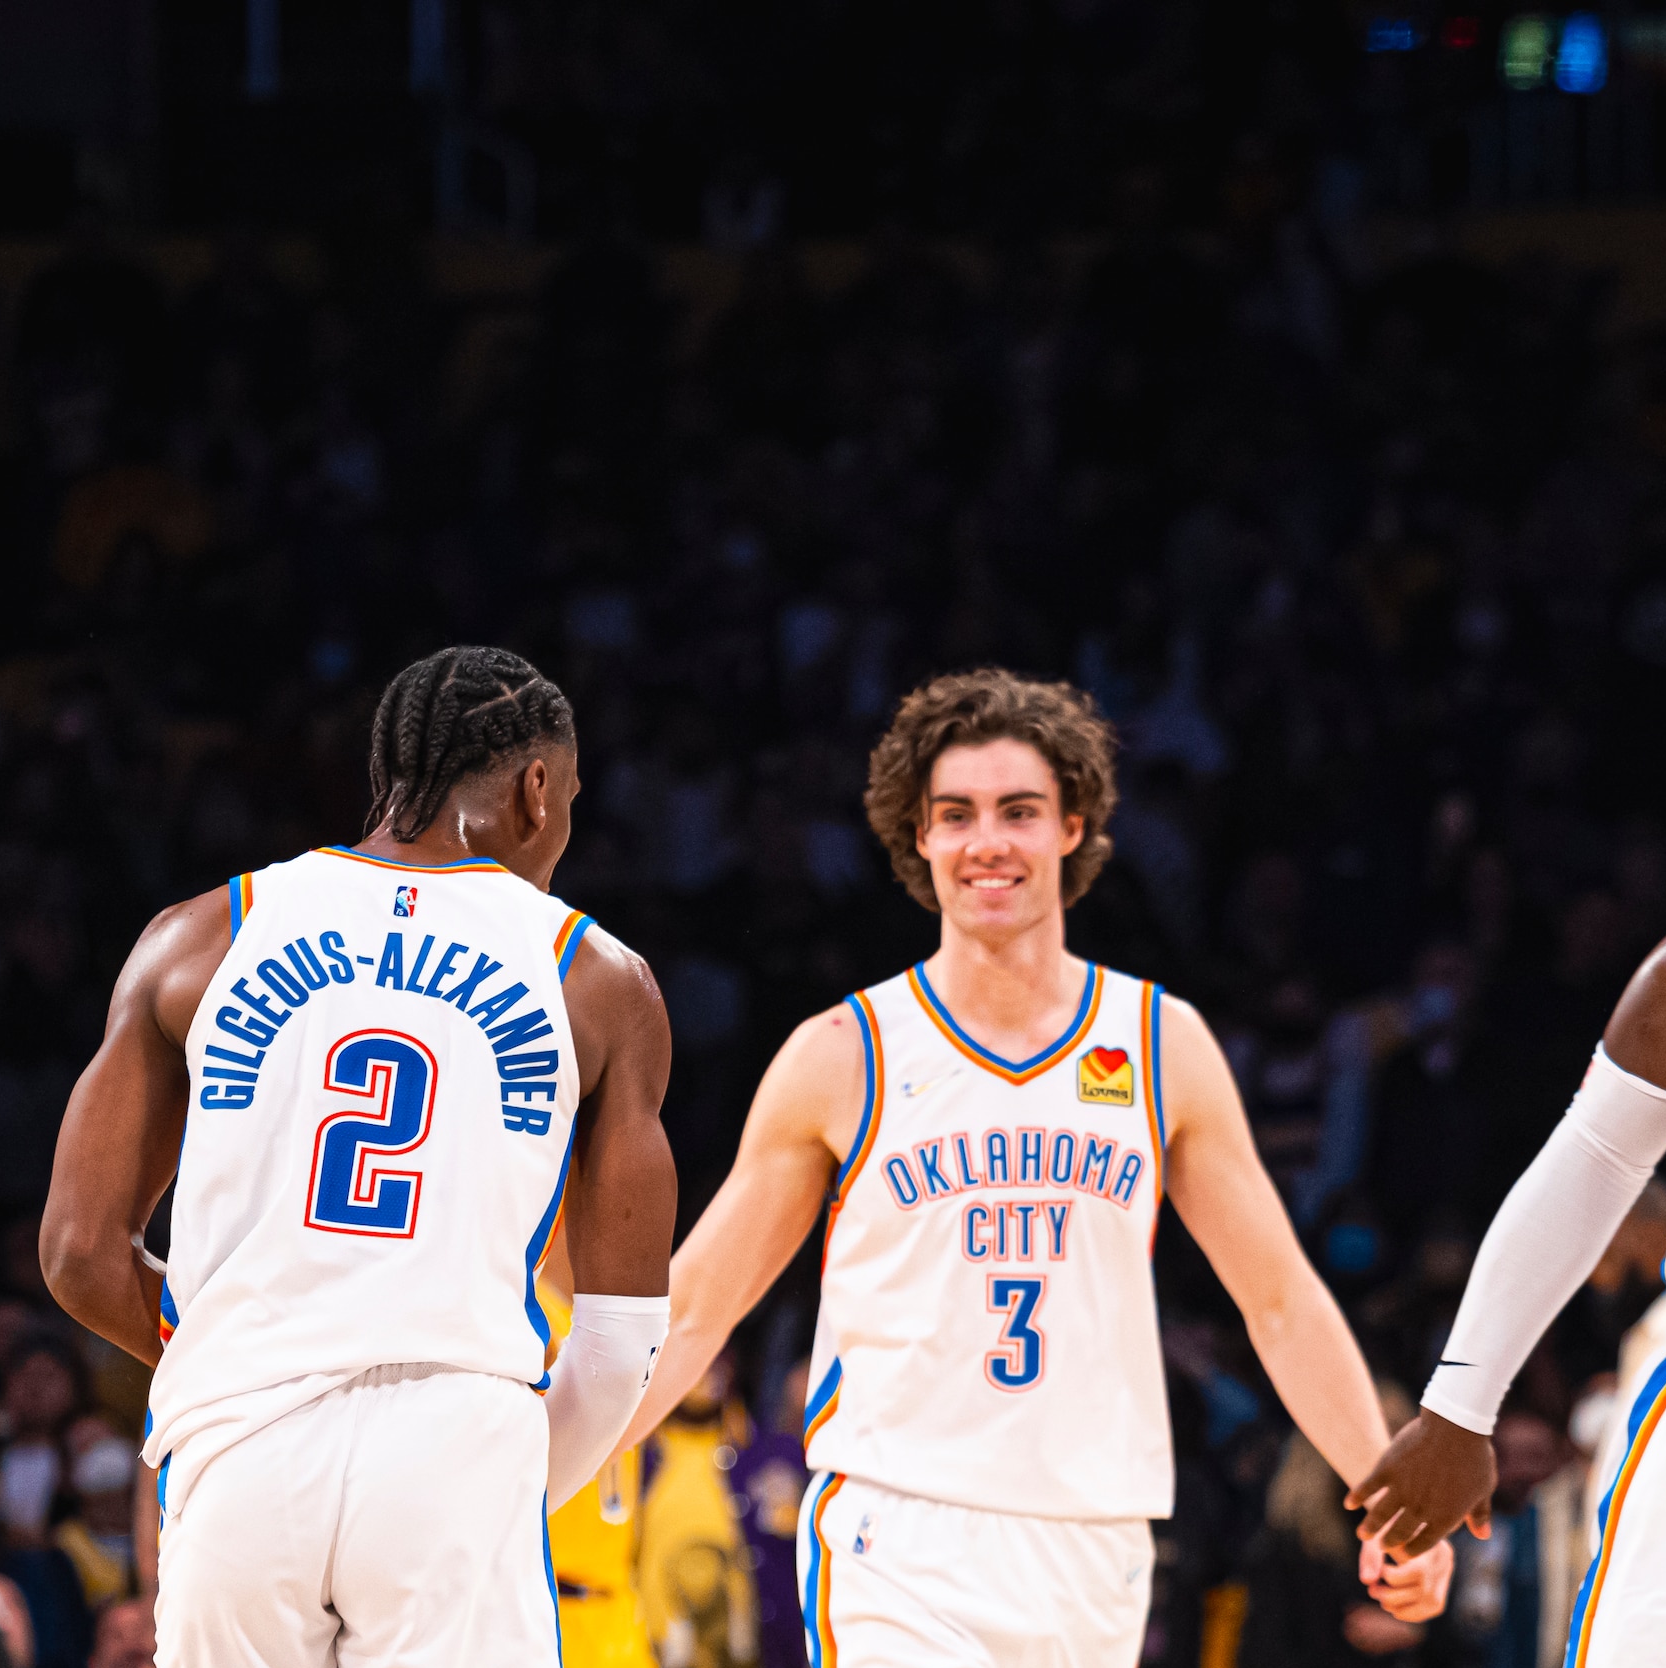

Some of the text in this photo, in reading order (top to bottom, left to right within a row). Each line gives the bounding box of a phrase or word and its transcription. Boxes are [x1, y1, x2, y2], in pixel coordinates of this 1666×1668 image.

[200, 930, 560, 1137] GILGEOUS-ALEXANDER
[303, 1028, 439, 1240] 2
[880, 1126, 1145, 1211] OKLAHOMA
[961, 1200, 1074, 1263] CITY
[983, 1273, 1047, 1393] 3
